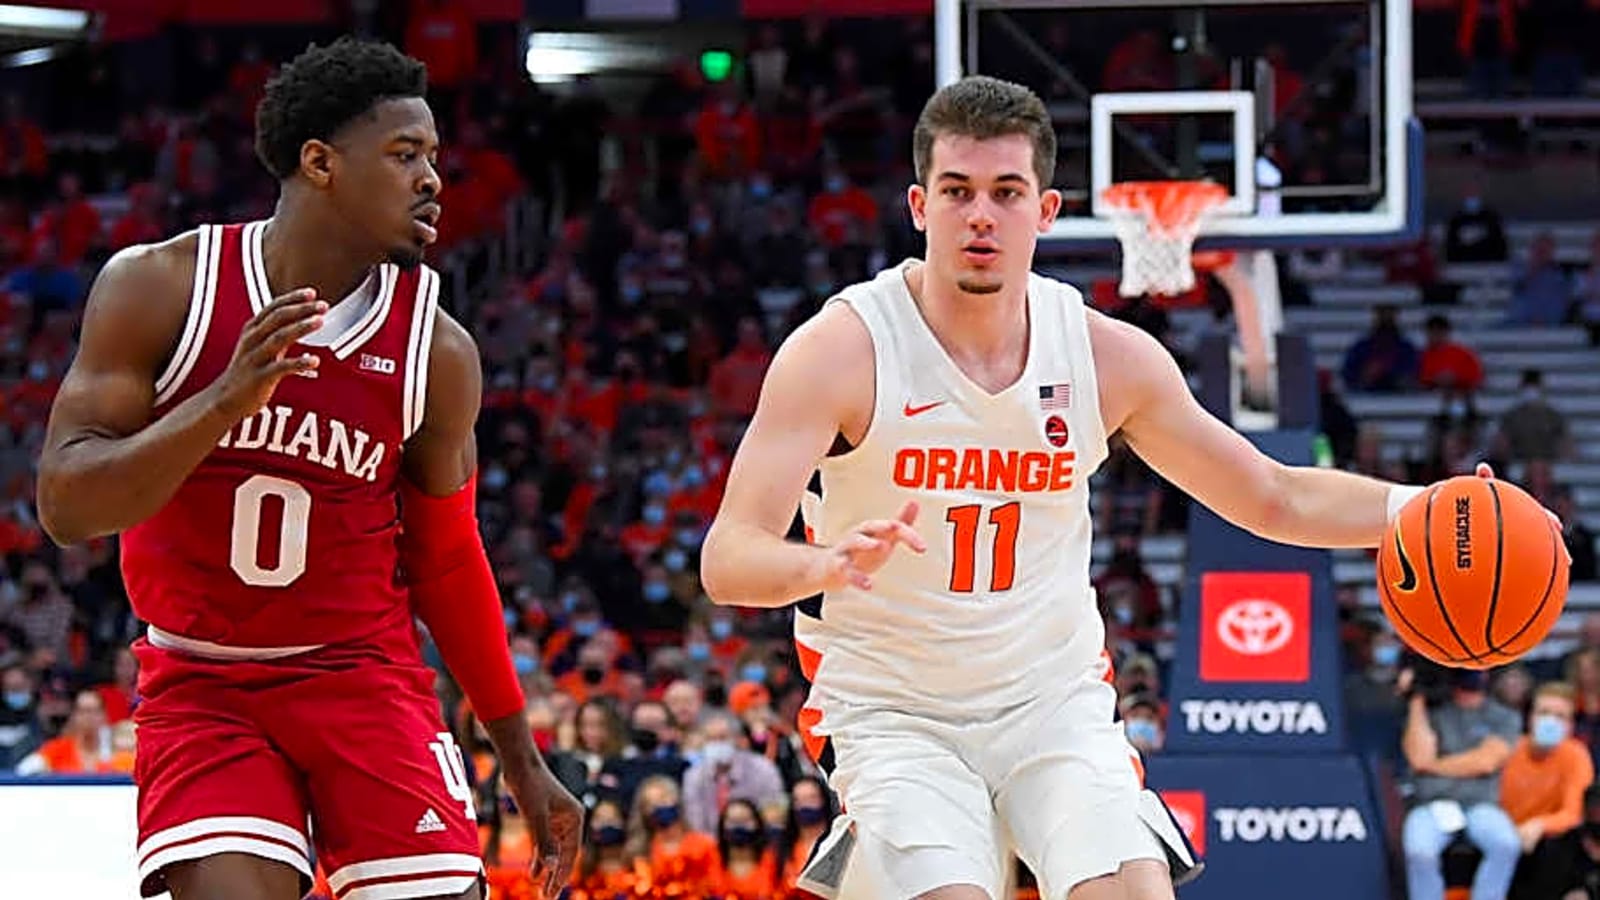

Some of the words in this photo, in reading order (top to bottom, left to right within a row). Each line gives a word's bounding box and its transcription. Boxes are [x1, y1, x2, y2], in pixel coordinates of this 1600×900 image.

[218, 405, 386, 481] DIANA
[893, 448, 1075, 492] ORANGE
[230, 474, 311, 587] 0
[946, 501, 1021, 593] 11
[1456, 496, 1472, 569] SYRACUSE
[1180, 700, 1327, 734] TOYOTA
[1214, 807, 1367, 841] TOYOTA
